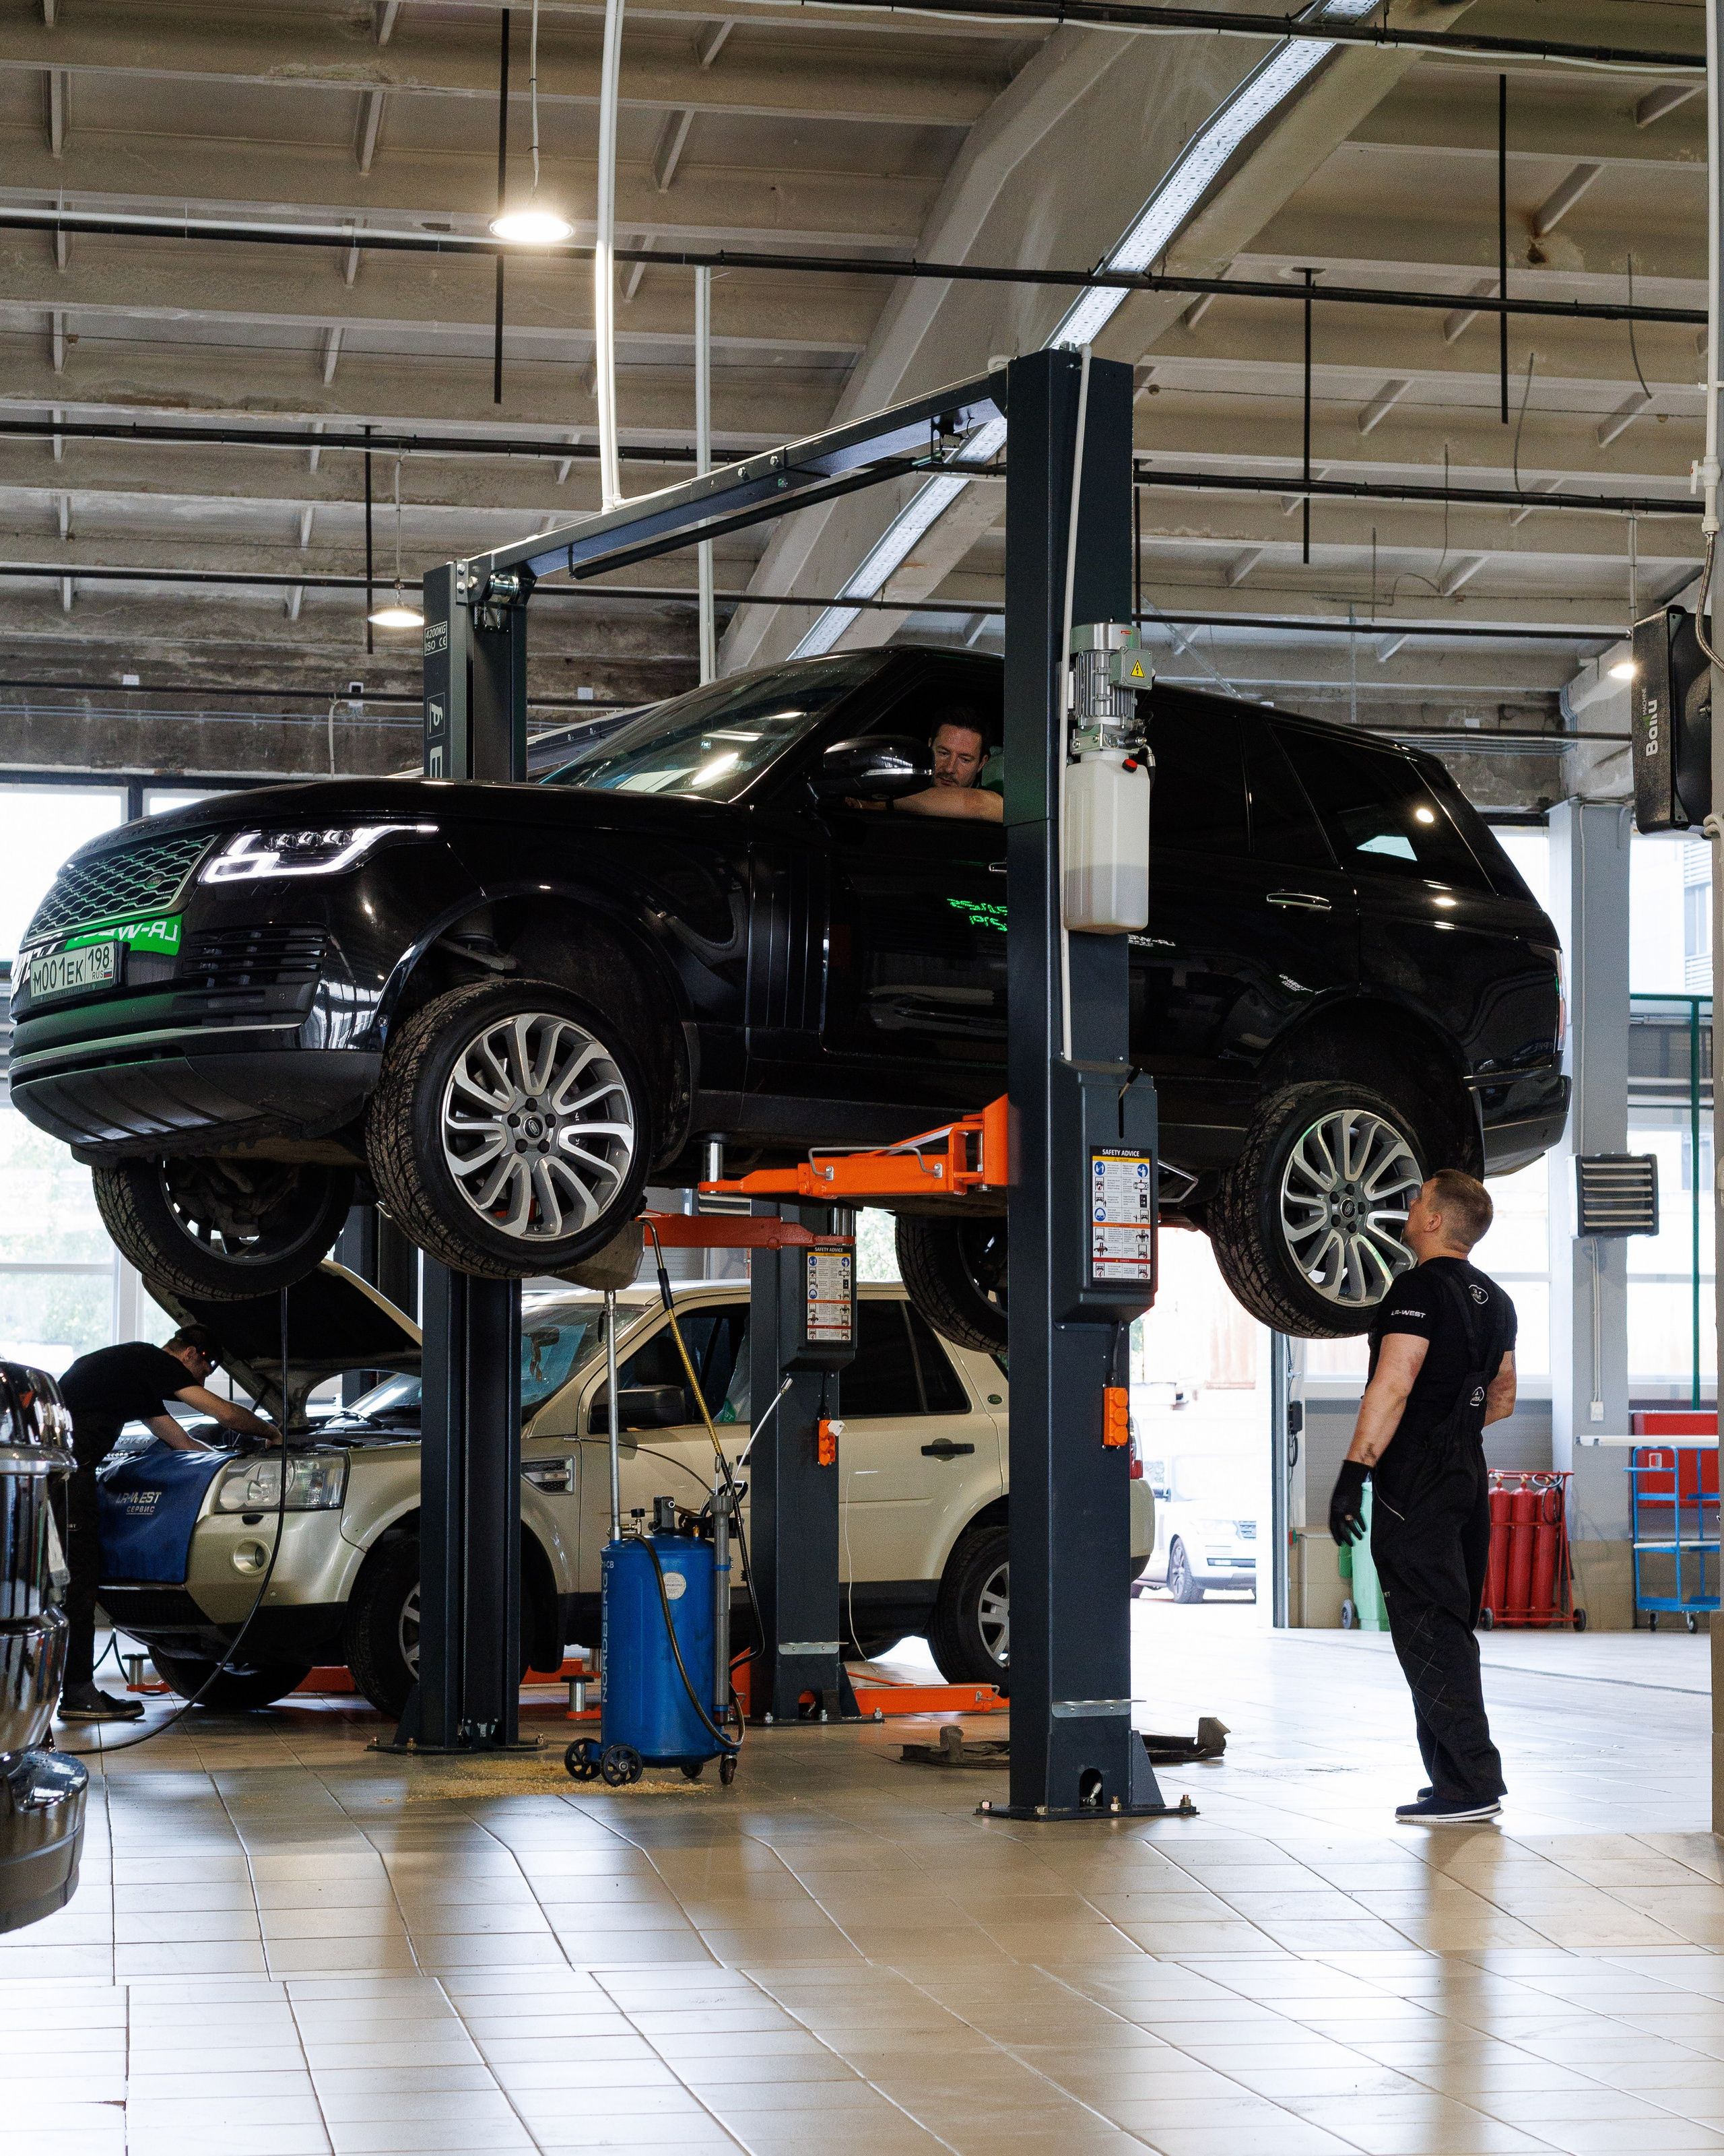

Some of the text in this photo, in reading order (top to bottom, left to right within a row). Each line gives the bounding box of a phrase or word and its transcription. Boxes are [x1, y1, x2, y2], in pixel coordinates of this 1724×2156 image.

[426, 624, 446, 639] 4200KG
[425, 637, 436, 652] ISO
[33, 956, 84, 993] M001EK
[88, 946, 110, 971] 198
[92, 970, 104, 980] RUS
[117, 1437, 150, 1445] ROVER
